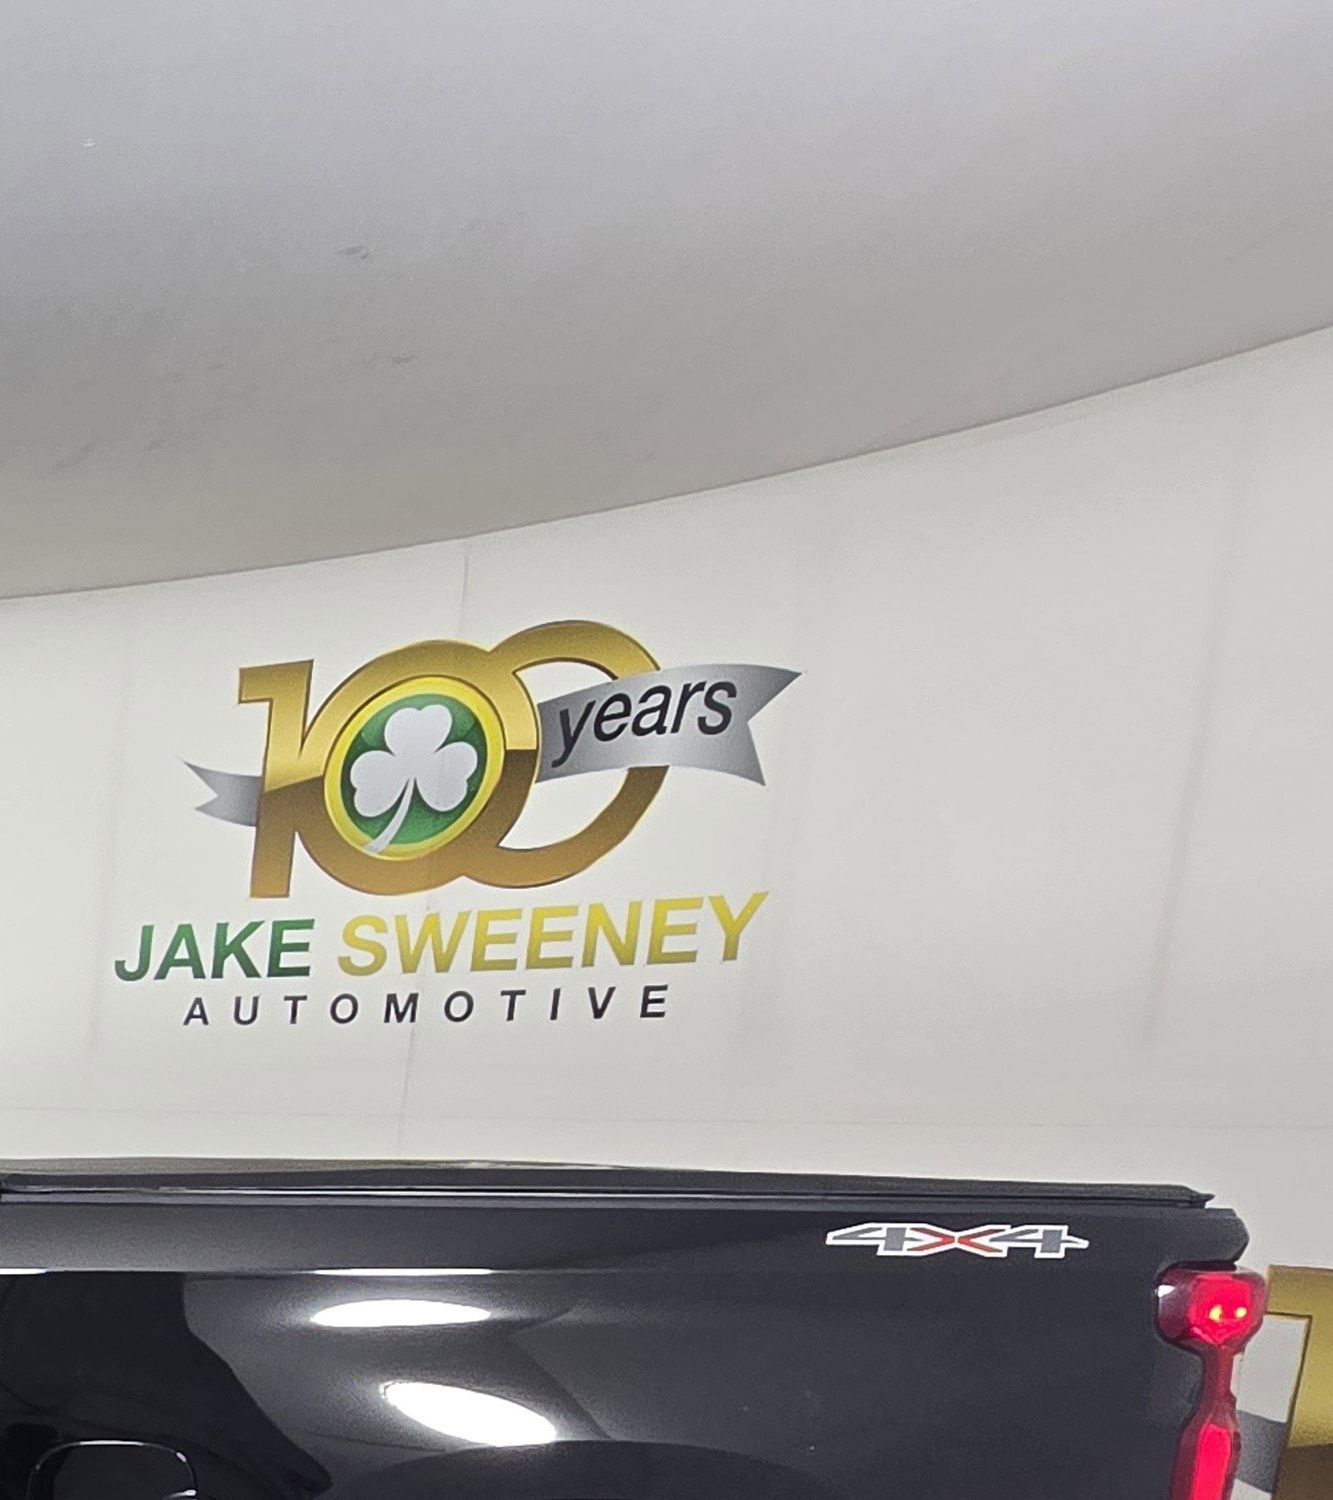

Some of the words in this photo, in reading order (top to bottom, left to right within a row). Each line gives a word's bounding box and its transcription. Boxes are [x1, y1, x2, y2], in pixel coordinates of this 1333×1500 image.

[237, 619, 669, 898] 100
[551, 678, 738, 768] years
[114, 918, 316, 981] JAKE
[337, 891, 770, 976] SWEENEY
[182, 983, 669, 1027] AUTOMOTIVE
